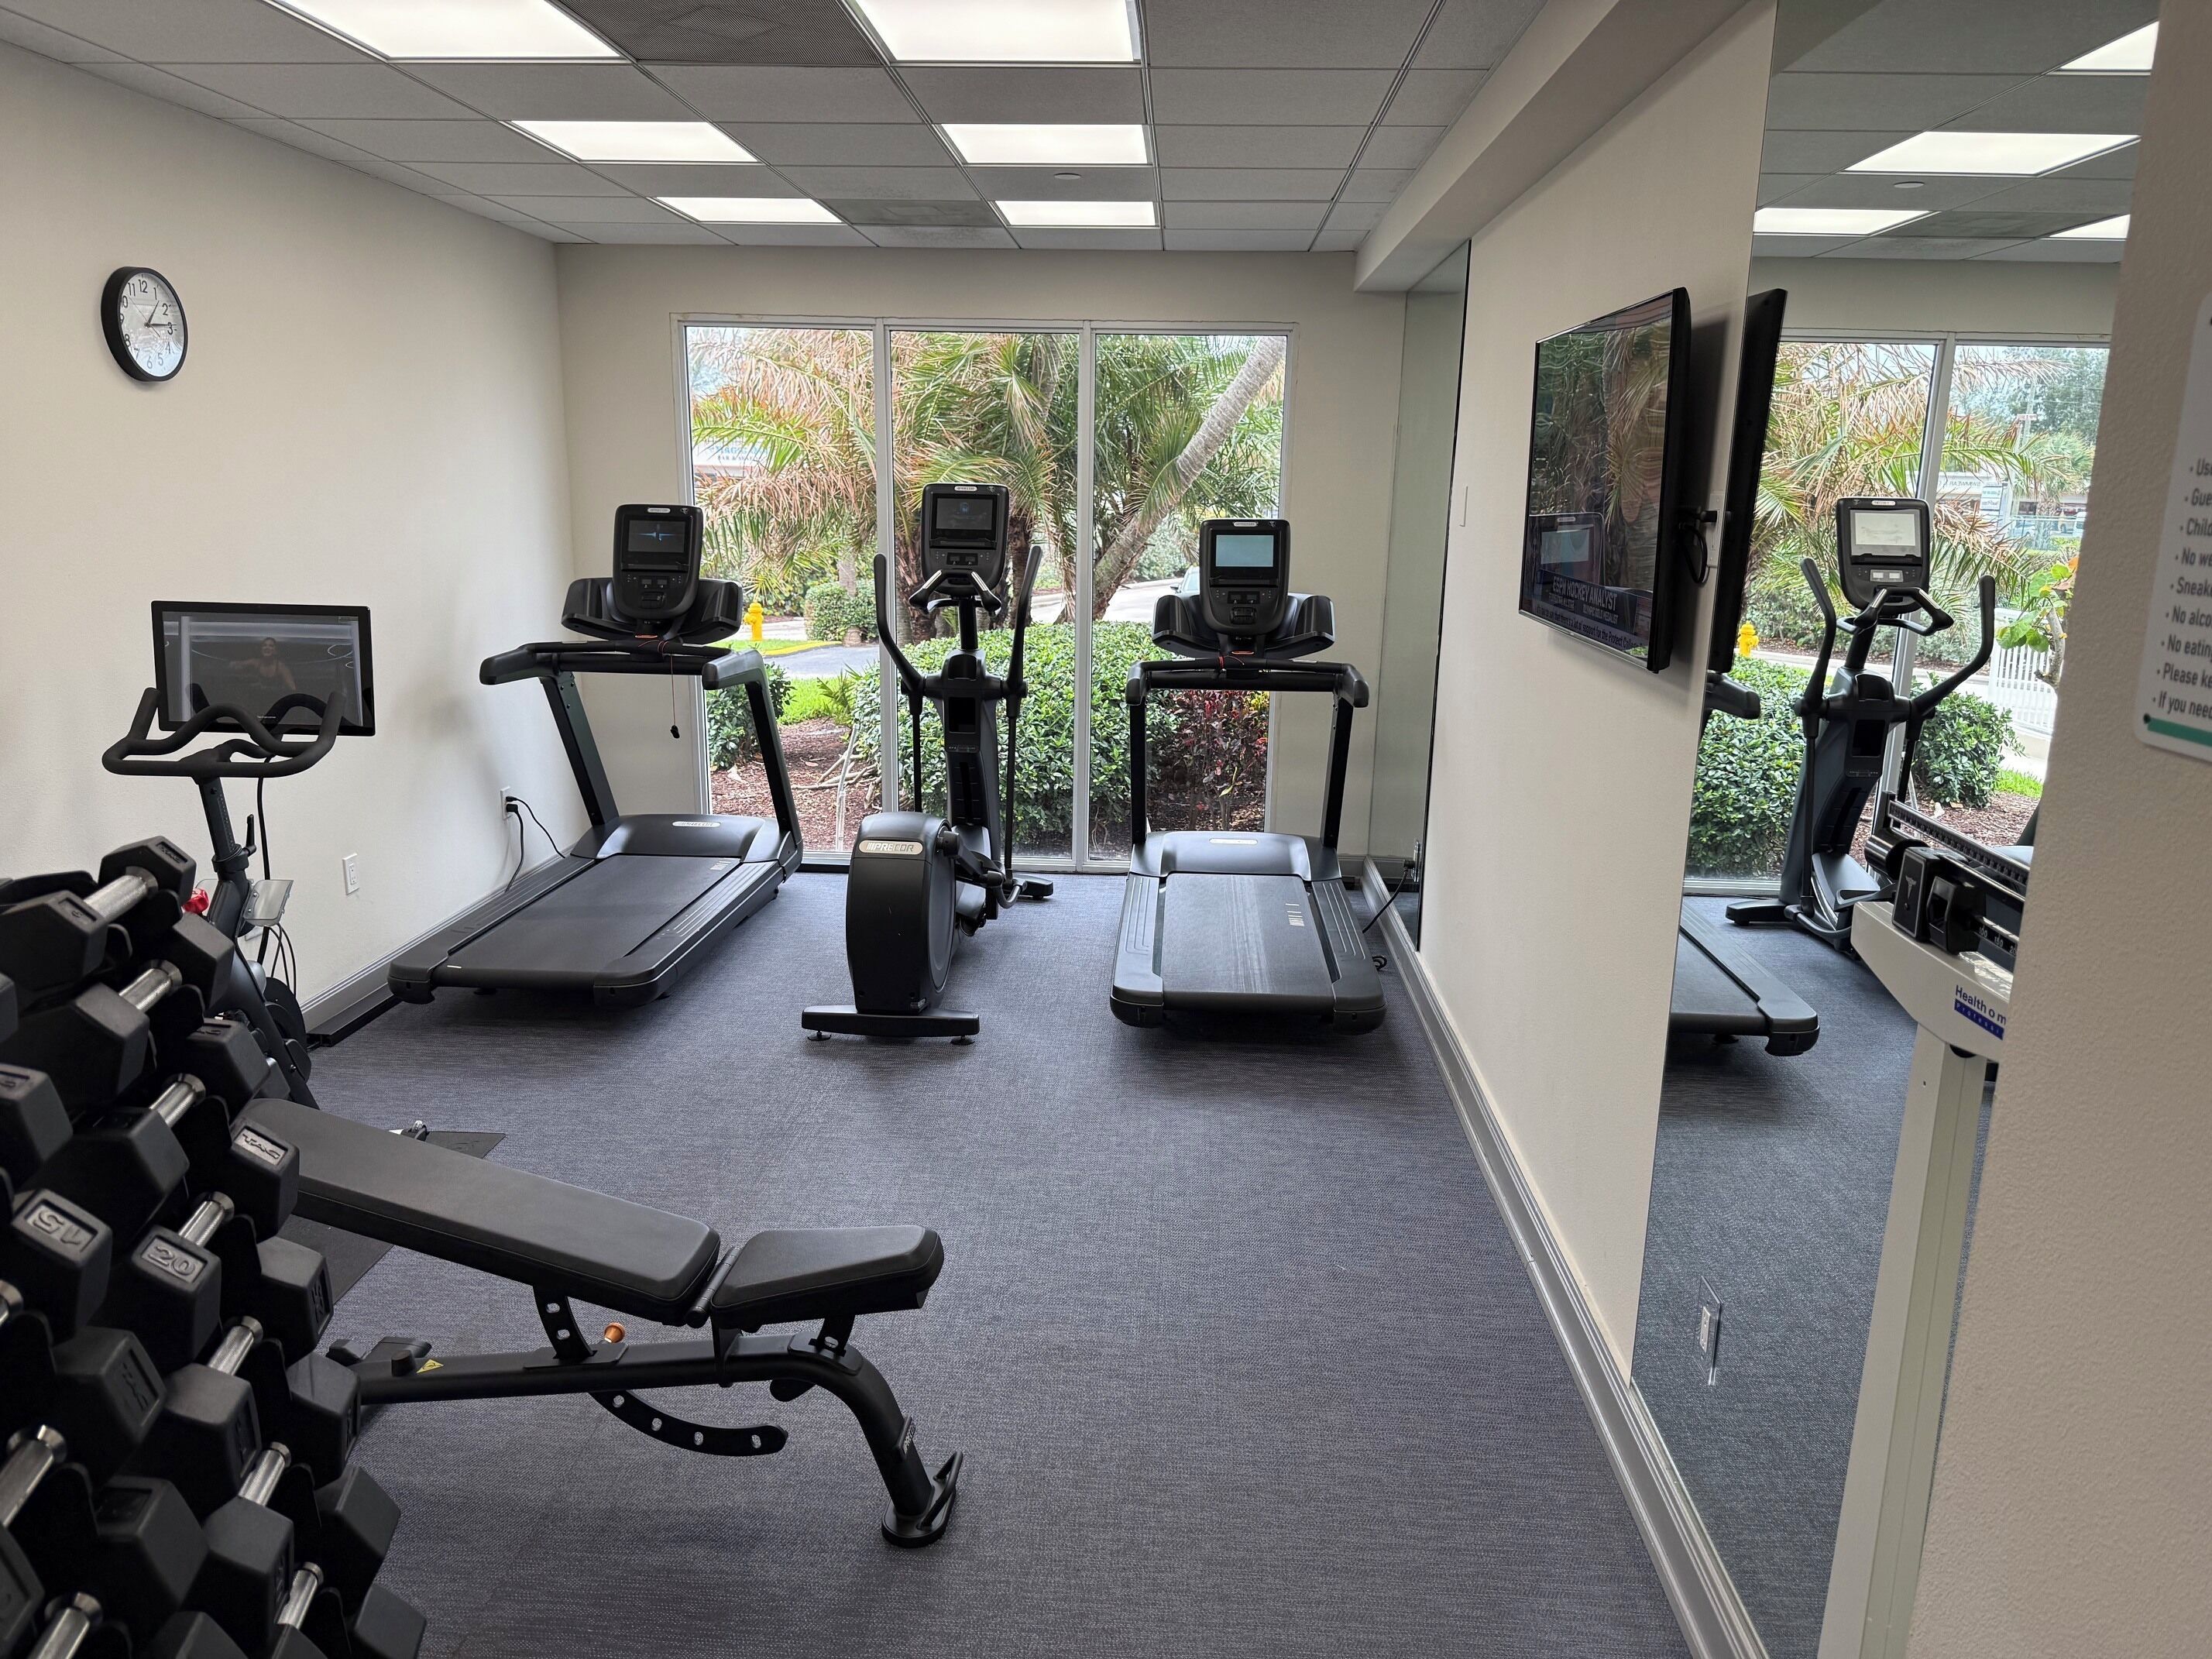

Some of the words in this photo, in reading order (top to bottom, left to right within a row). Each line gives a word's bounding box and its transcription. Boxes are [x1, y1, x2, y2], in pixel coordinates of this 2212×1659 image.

[128, 283, 136, 297] 11
[139, 280, 148, 294] 12
[153, 287, 157, 300] 1
[162, 303, 169, 316] 2
[167, 322, 173, 335] 3
[125, 334, 131, 347] 8
[146, 356, 153, 369] 6
[157, 353, 163, 366] 5
[2197, 459, 2212, 476] Us
[2182, 547, 2196, 566] No
[1553, 576, 1566, 595] ESPN
[1566, 581, 1589, 601] HOCKEY
[1589, 587, 1617, 611] ANALYST
[2172, 606, 2186, 624] No
[2167, 634, 2181, 652] No
[2162, 662, 2198, 685] Please
[2159, 690, 2167, 708] If
[2167, 696, 2186, 714] you
[871, 843, 914, 852] PRECOR
[1956, 984, 1987, 1014] Health
[32, 1208, 82, 1245] 15
[146, 1245, 196, 1276] 20
